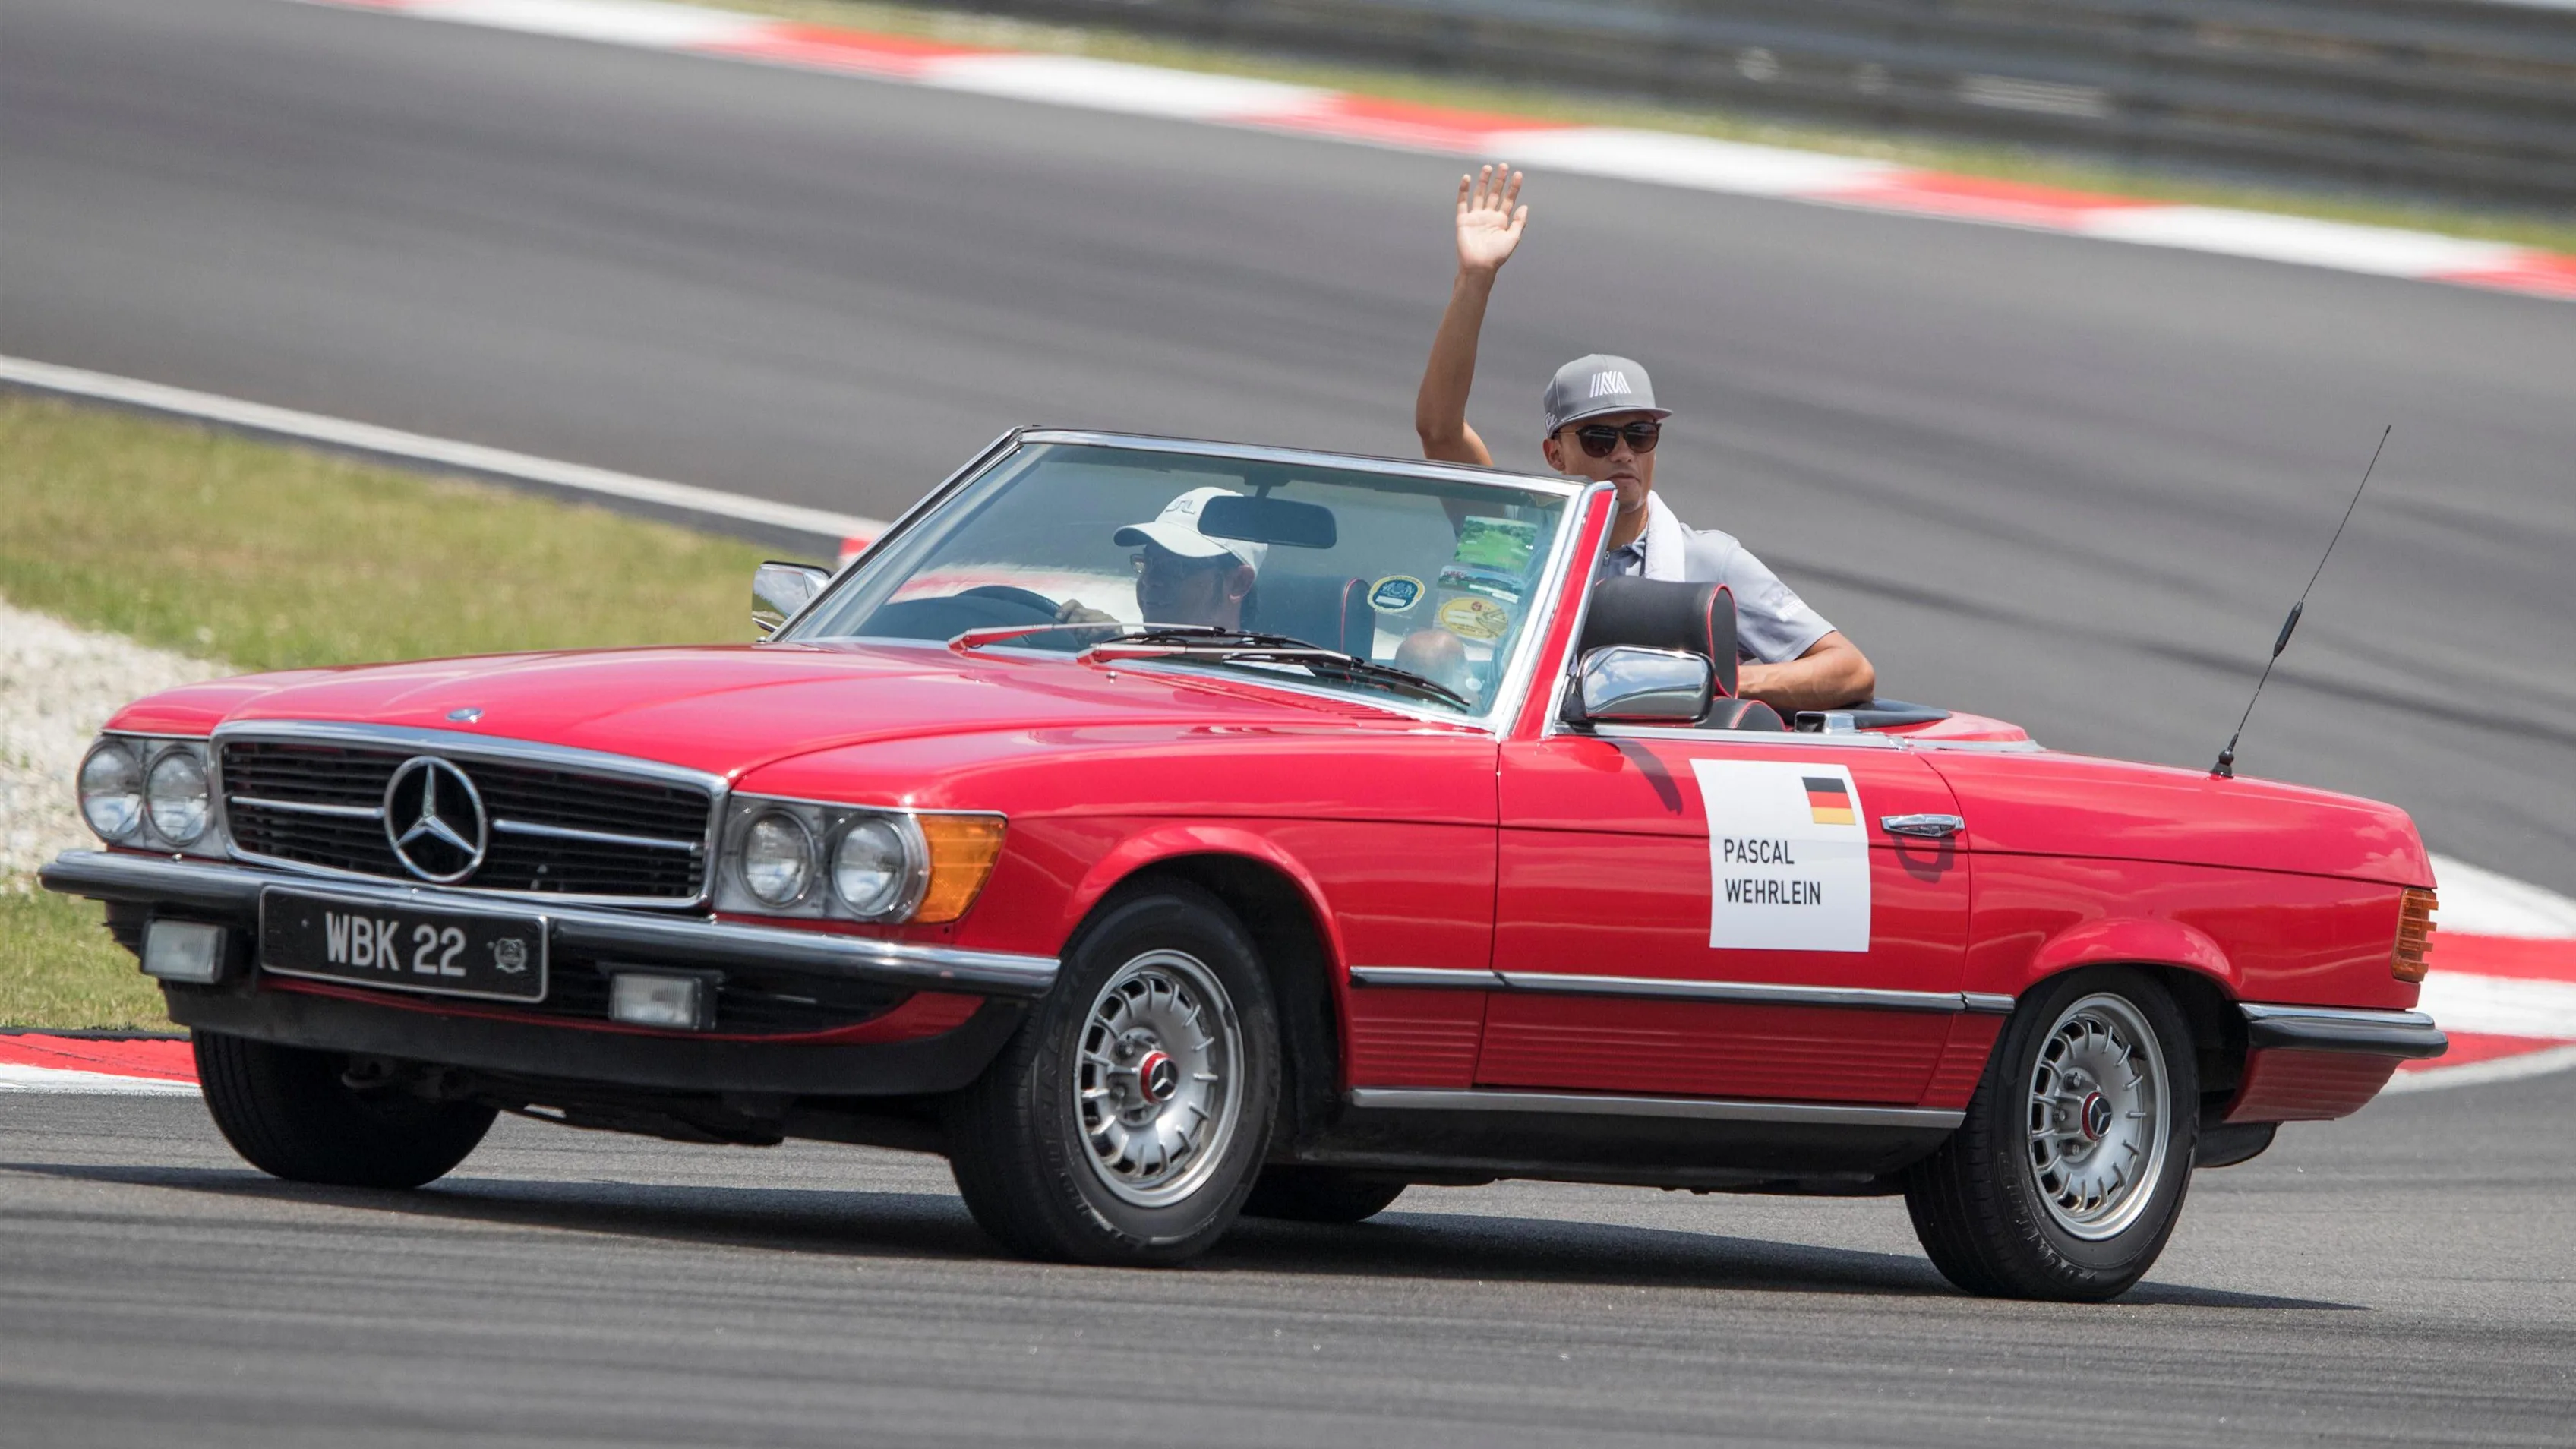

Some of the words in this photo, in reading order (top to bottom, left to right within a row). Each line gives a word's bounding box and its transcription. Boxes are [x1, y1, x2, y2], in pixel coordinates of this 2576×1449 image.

[1724, 838, 1795, 864] PASCAL
[1725, 879, 1821, 905] WEHRLEIN
[325, 911, 401, 971] WBK
[413, 924, 466, 977] 22
